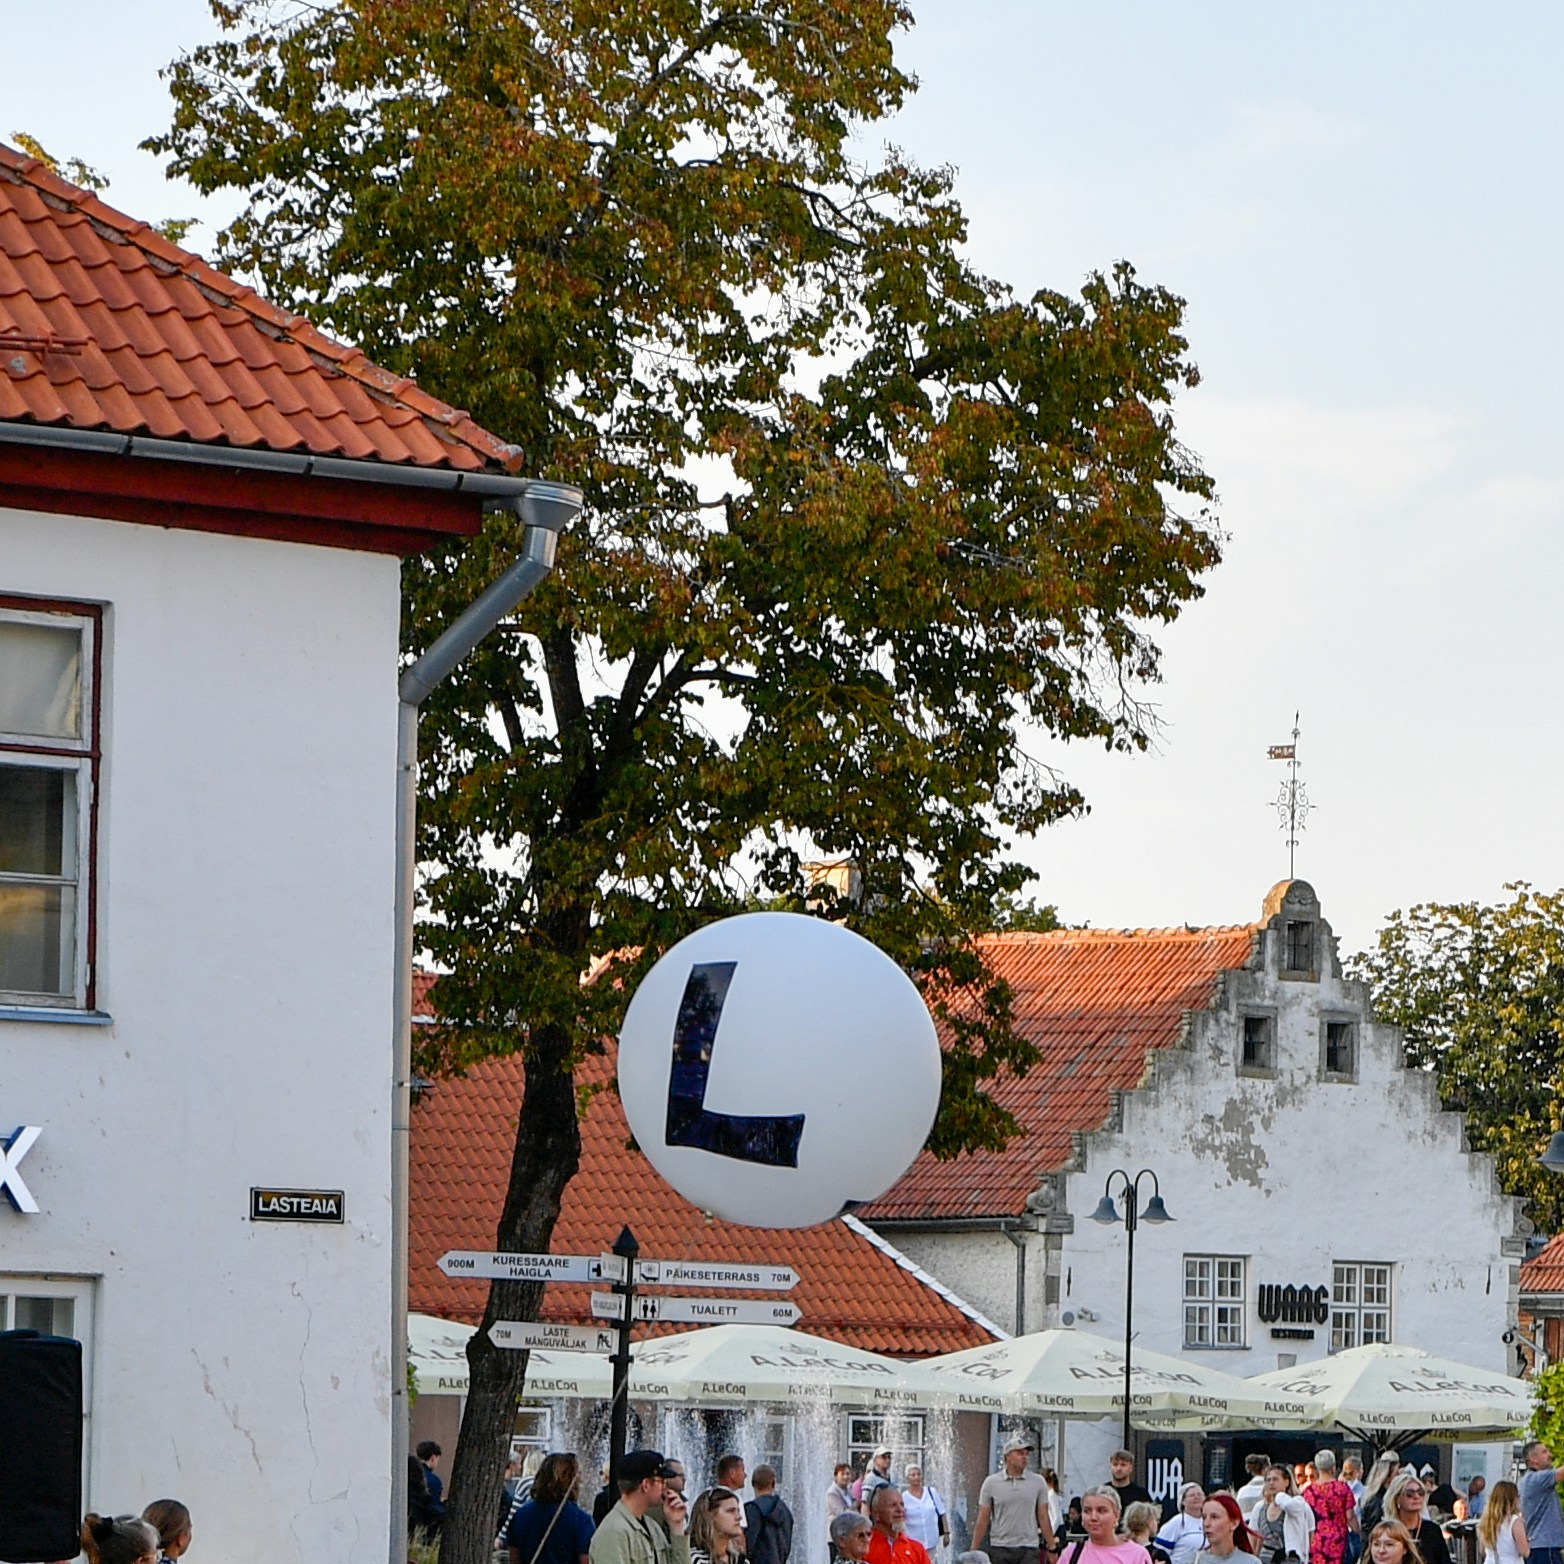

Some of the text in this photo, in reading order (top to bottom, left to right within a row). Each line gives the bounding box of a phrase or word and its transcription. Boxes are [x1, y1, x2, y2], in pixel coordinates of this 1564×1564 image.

[666, 961, 805, 1168] L
[258, 1196, 337, 1215] LASTEAIA
[447, 1259, 475, 1269] 900M
[492, 1256, 570, 1268] KURESSAARE
[509, 1268, 552, 1278] HAIGLA
[665, 1268, 791, 1283] PÄIKESETERRASS 70M
[690, 1304, 793, 1318] TUALETT 60M
[495, 1329, 512, 1339] 70M
[543, 1326, 570, 1337] LASTE
[525, 1336, 587, 1349] MÄNGUVÄLJAK
